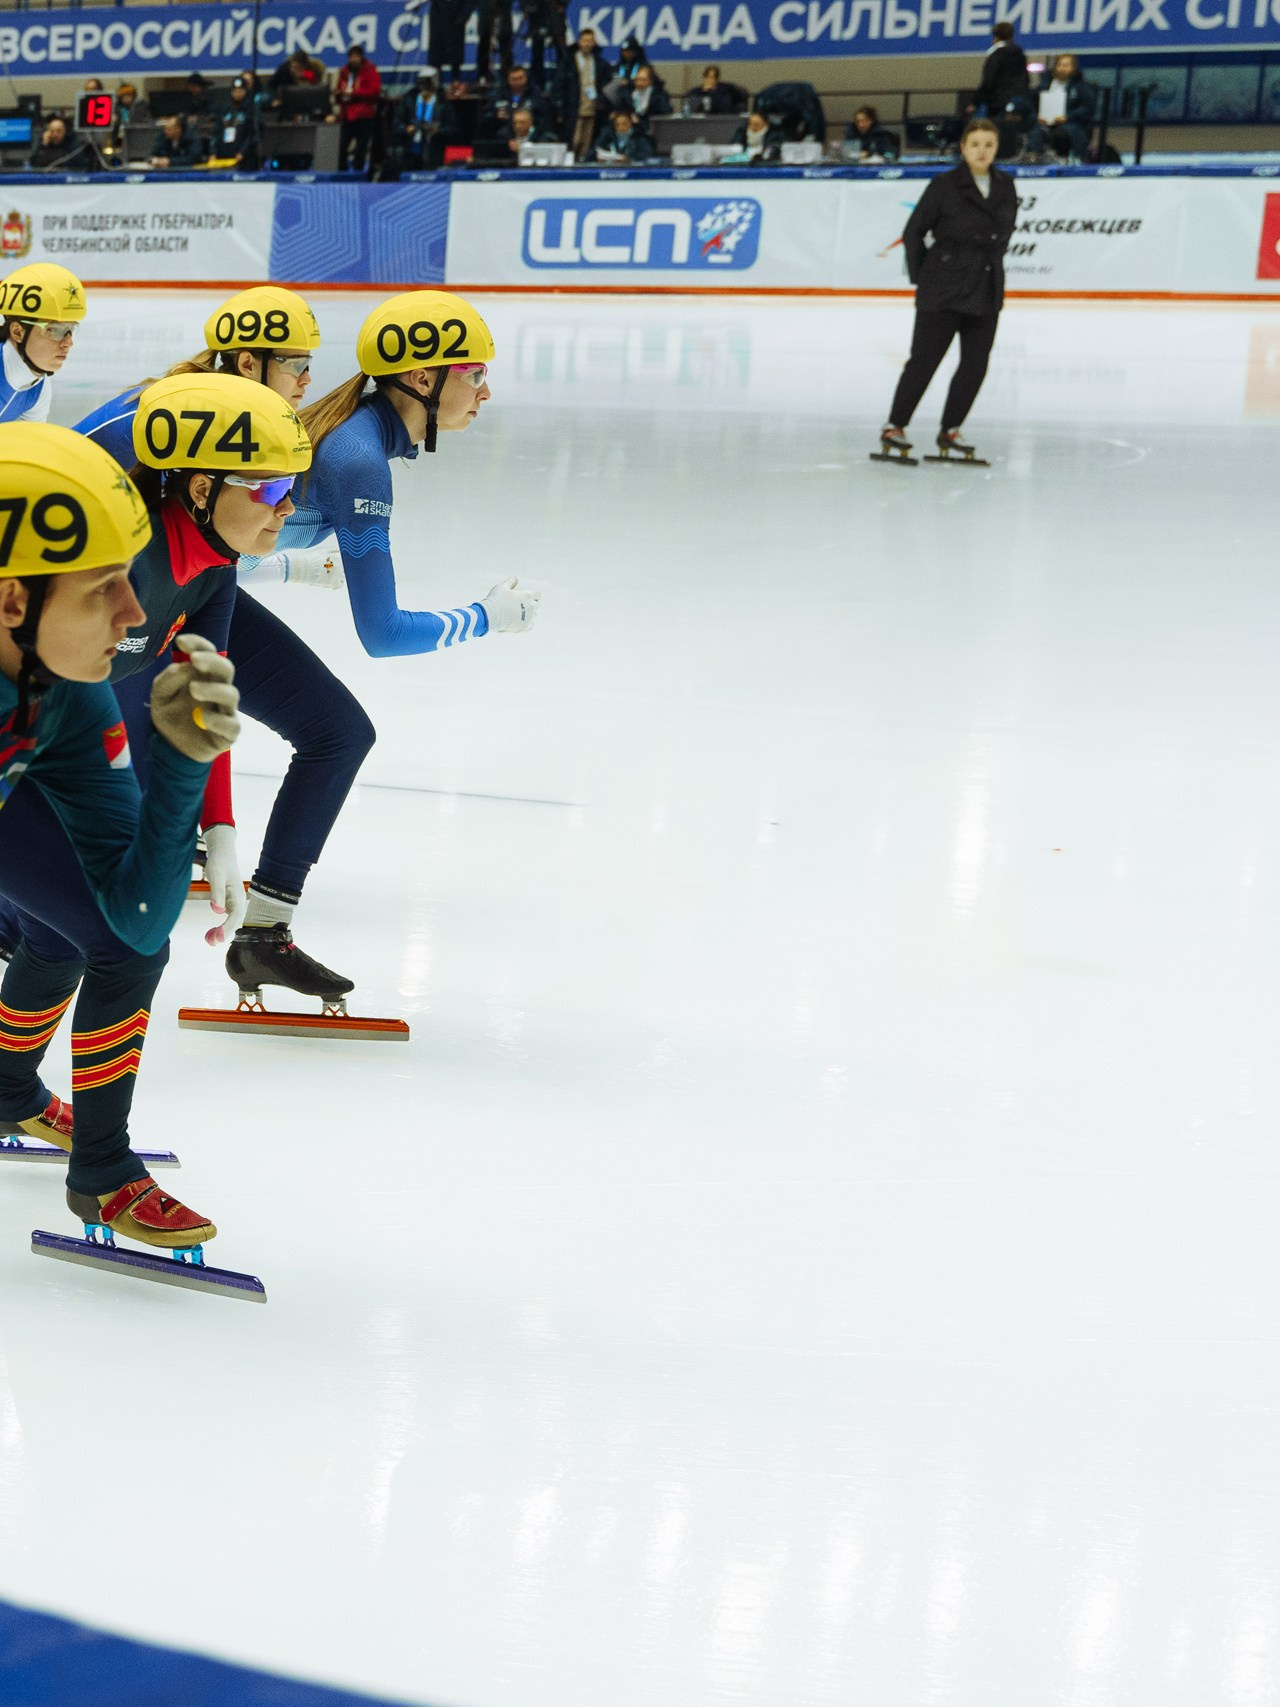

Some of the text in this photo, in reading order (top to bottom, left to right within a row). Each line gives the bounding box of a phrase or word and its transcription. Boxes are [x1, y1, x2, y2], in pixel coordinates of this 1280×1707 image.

[388, 2, 757, 53] СКИАДА
[87, 96, 110, 126] 13
[43, 213, 234, 231] ПРИ ПОДДЕРЖКЕ ГУБЕРНАТОРА
[528, 208, 692, 264] ЦСП
[1018, 219, 1142, 236] КОБЕЖЦЕВ
[42, 234, 188, 253] ЧЕЛЯБИНСКОЙ ОБЛАСТИ
[215, 309, 290, 345] 098
[376, 318, 470, 363] 092
[145, 408, 260, 463] 074
